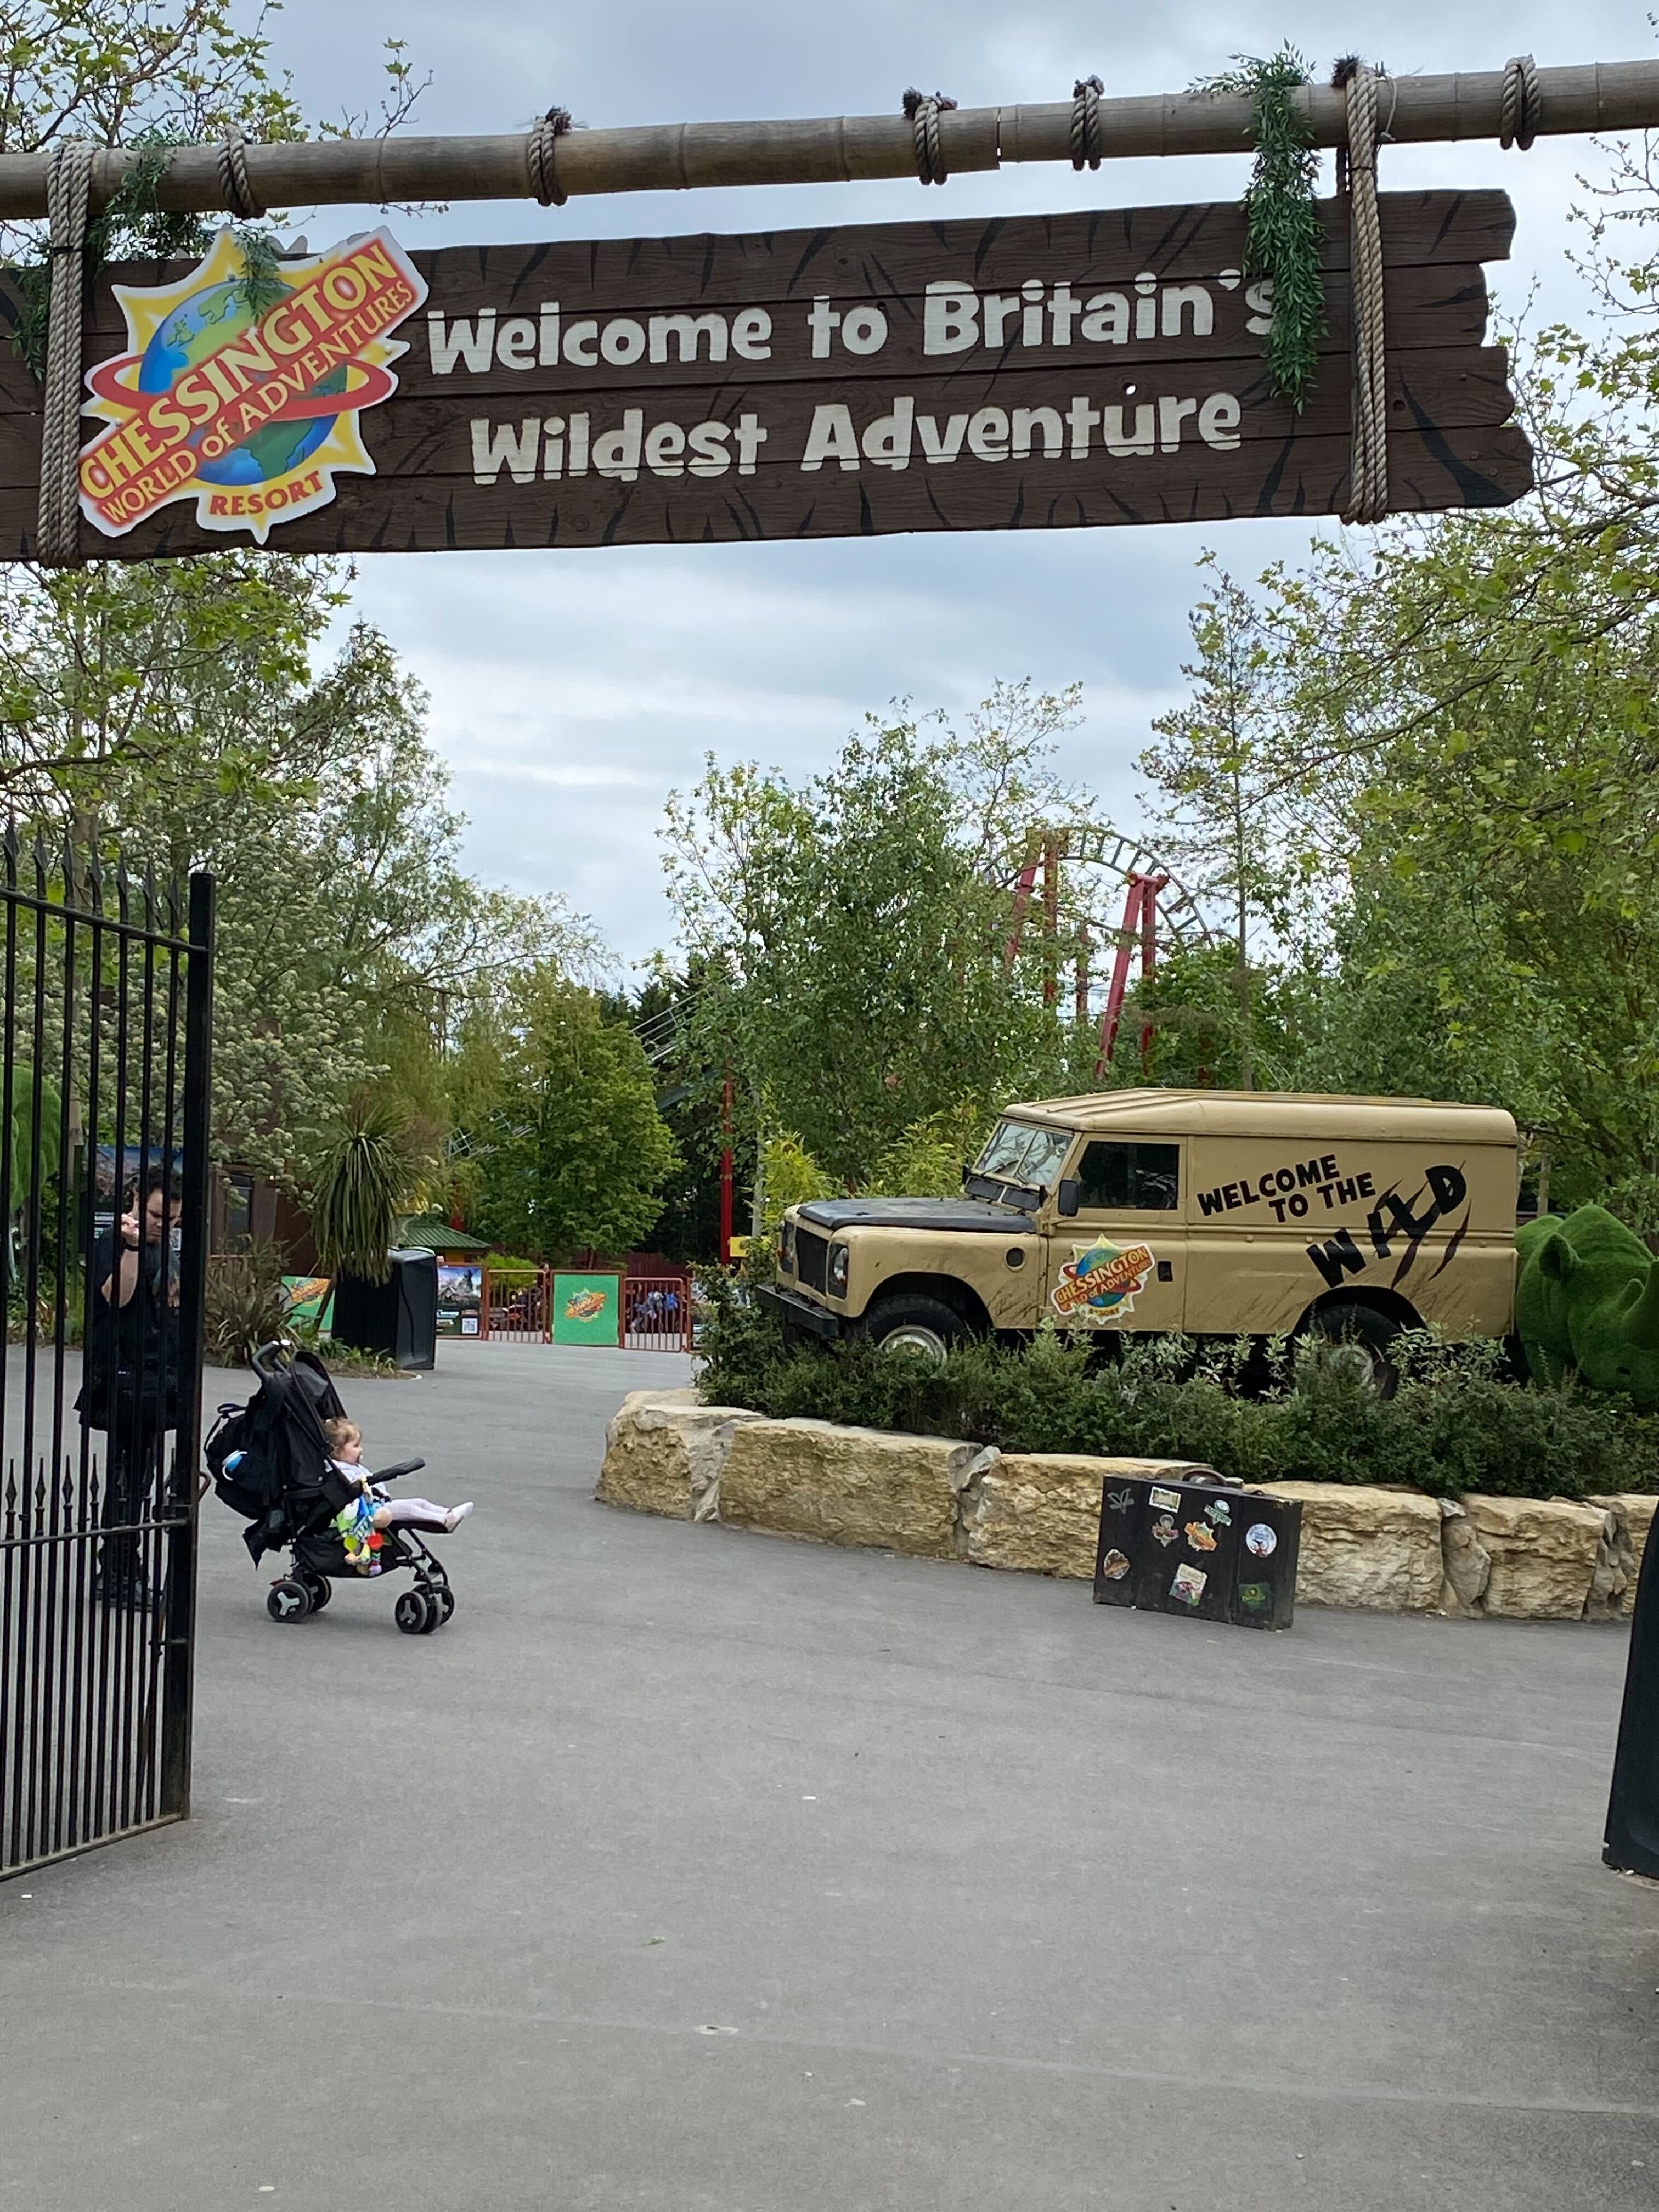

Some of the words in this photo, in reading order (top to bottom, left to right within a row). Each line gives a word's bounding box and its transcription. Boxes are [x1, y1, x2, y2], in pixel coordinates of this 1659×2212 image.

[80, 244, 397, 499] CHESSINGTON
[427, 301, 772, 375] Welcome
[807, 295, 888, 358] to
[100, 449, 198, 523] WORLD
[201, 421, 235, 458] of
[239, 280, 414, 433] ADVENTURES
[470, 408, 768, 485] Wildest
[800, 391, 1242, 472] Adventure
[209, 471, 323, 516] RESORT
[1197, 1154, 1340, 1216] WELCOME
[1269, 1193, 1309, 1223] TO
[1317, 1172, 1376, 1209] THE
[1306, 1165, 1467, 1289] WILD
[1056, 1248, 1148, 1304] CHESSINGTON
